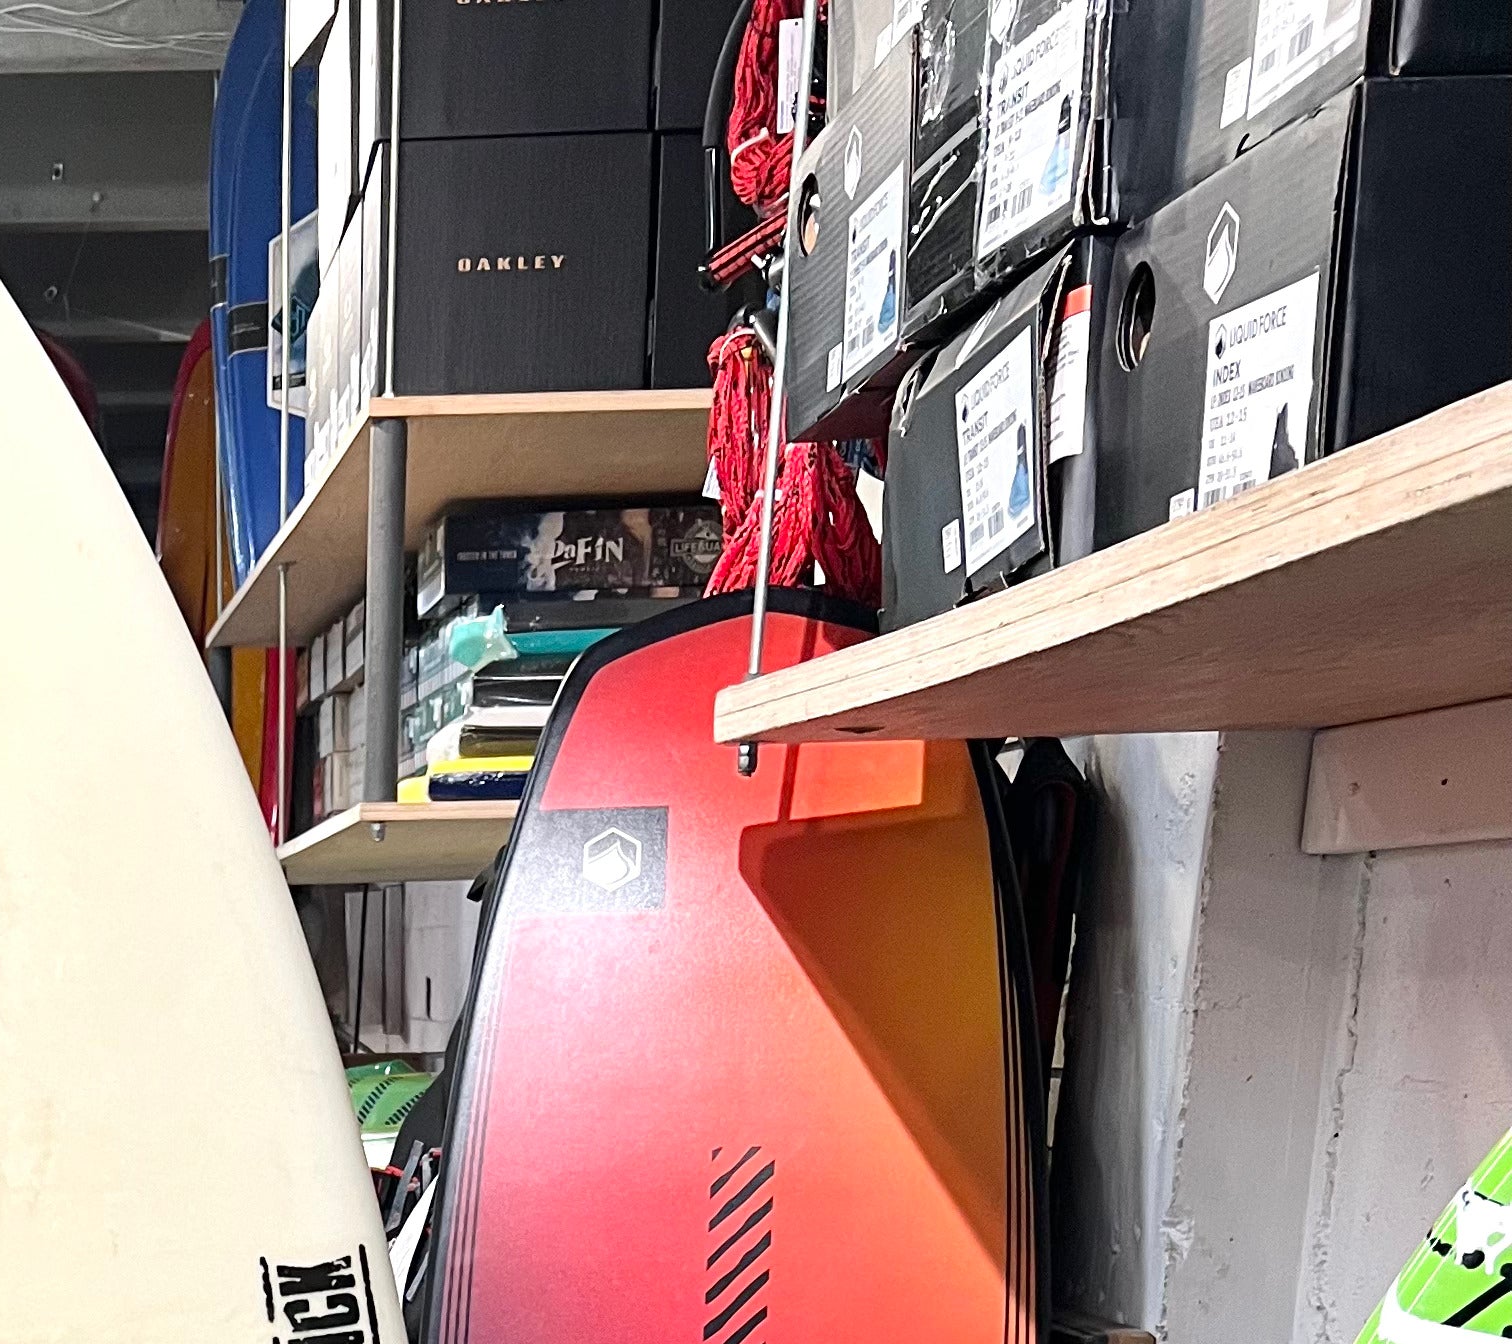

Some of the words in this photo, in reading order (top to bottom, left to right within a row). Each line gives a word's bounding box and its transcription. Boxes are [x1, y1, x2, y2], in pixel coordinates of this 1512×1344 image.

[457, 255, 567, 272] OAKLEY
[1229, 318, 1258, 347] LIQUID
[1259, 305, 1287, 335] FORCE
[1213, 359, 1242, 387] INDEX
